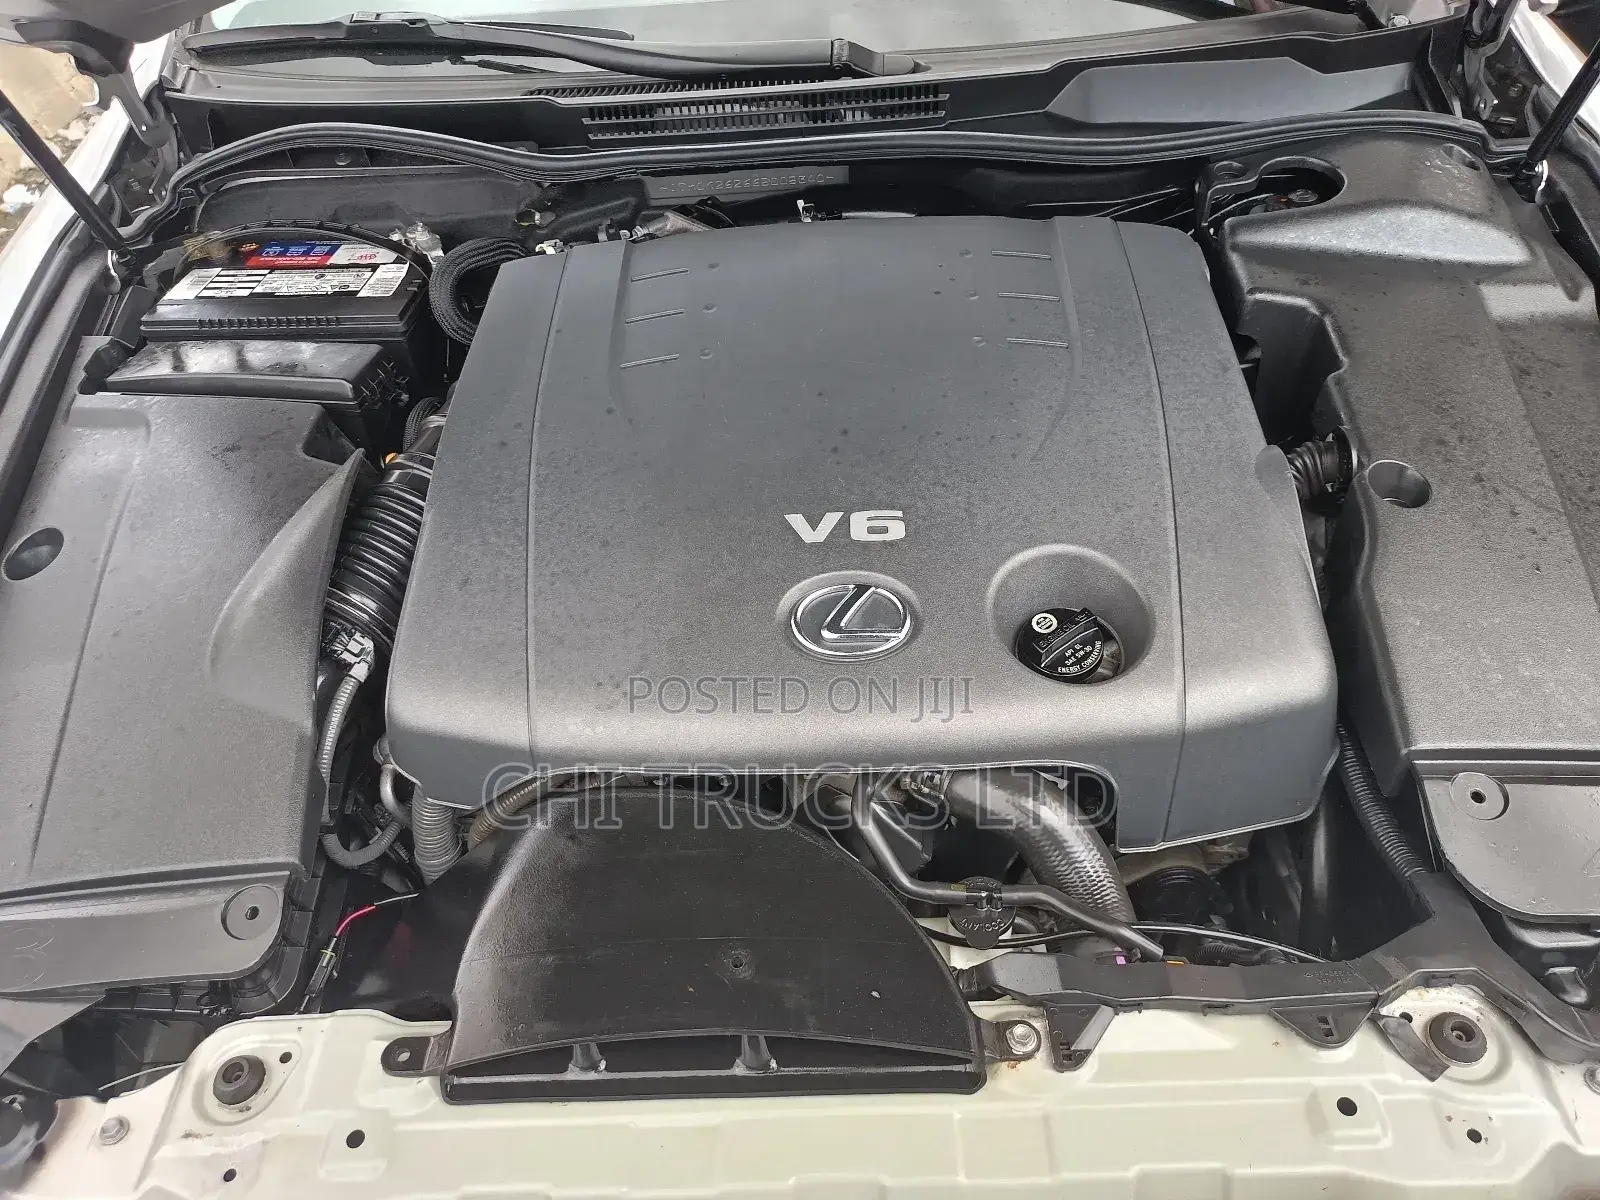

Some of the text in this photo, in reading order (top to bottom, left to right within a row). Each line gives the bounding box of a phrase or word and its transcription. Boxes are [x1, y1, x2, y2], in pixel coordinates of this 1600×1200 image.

[784, 509, 906, 543] V6
[1057, 640, 1102, 673] ENERGY CONSERVING
[1064, 648, 1075, 658] API
